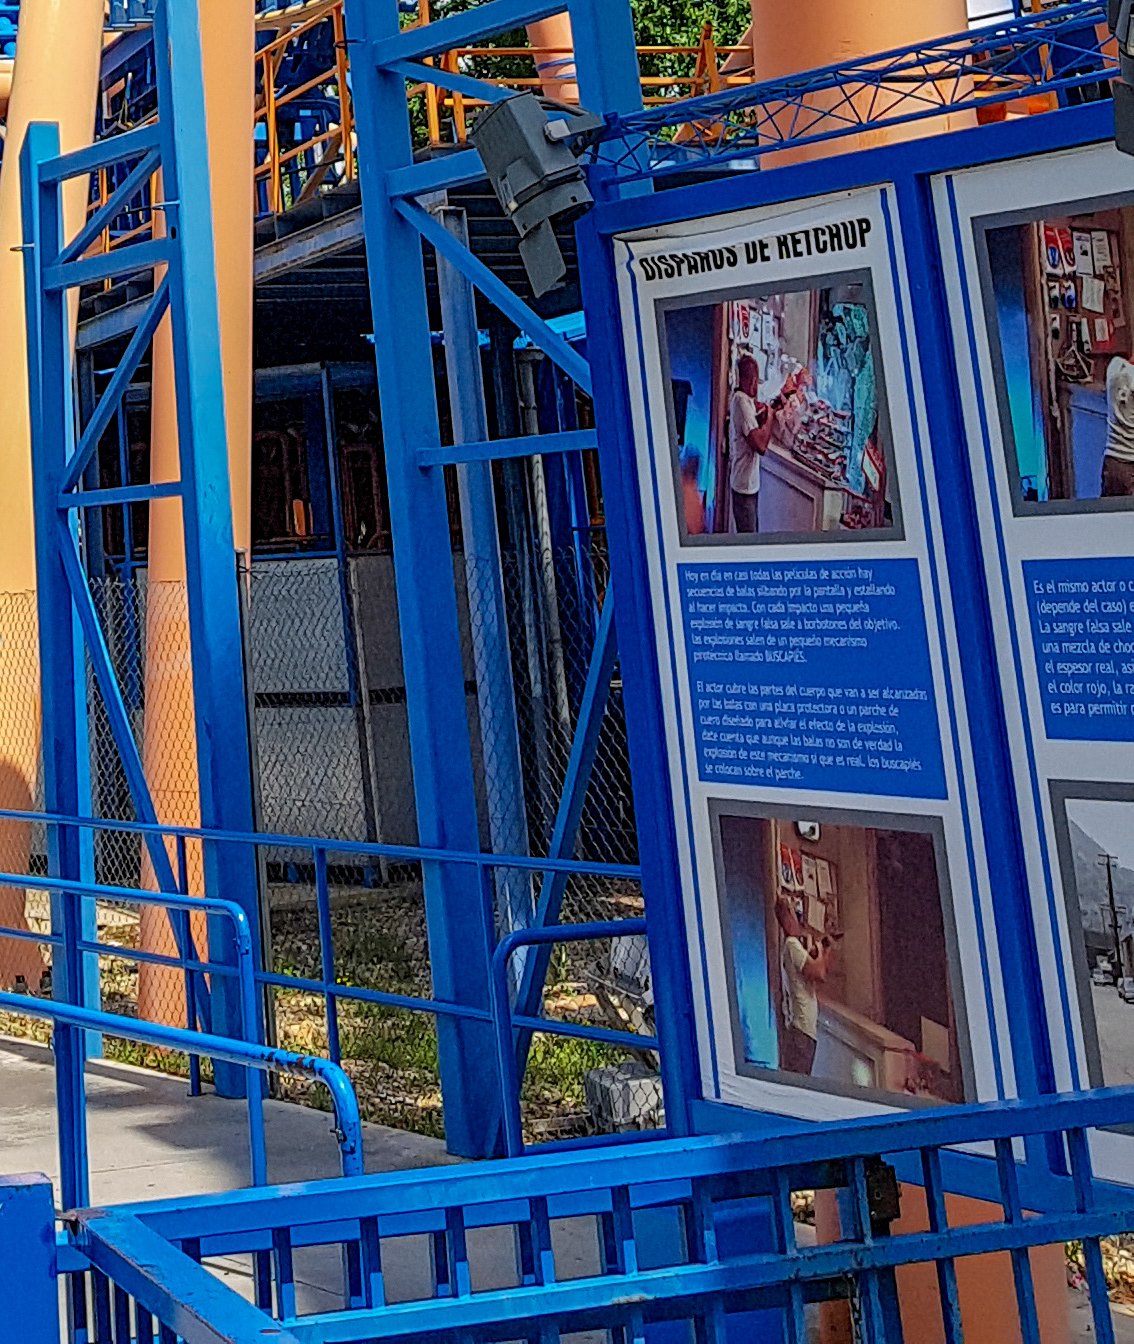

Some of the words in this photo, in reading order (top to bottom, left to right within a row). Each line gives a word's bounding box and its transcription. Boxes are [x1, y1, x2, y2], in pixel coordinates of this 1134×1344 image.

[744, 239, 771, 265] DE
[775, 218, 872, 260] KETCHUP
[685, 570, 698, 583] Hoy
[700, 572, 709, 581] en
[724, 572, 733, 581] en
[750, 569, 770, 581] todas
[772, 569, 782, 581] las
[820, 568, 829, 580] de
[858, 567, 872, 582] hay
[726, 585, 735, 596] de
[736, 585, 756, 596] balas
[790, 587, 801, 598] por
[804, 585, 811, 596] la
[814, 584, 845, 599] pantalla
[847, 587, 852, 599] y
[854, 583, 896, 596] estallando
[1034, 580, 1045, 594] Es
[1047, 580, 1056, 594] el
[1058, 580, 1089, 593] mismo
[1092, 579, 1116, 593] actor
[1119, 581, 1126, 592] o
[689, 602, 695, 612] al
[752, 601, 766, 614] Con
[768, 601, 785, 613] cada
[819, 603, 833, 613] una
[1037, 600, 1081, 616] (depende
[1084, 598, 1099, 613] del
[1101, 598, 1127, 616] caso)
[725, 617, 734, 629] de
[780, 617, 796, 629] sale
[804, 617, 847, 630] borbotones
[849, 617, 862, 629] del
[864, 617, 901, 632] objetivo.
[1039, 619, 1051, 634] La
[1053, 622, 1083, 637] sangre
[1086, 618, 1110, 633] falsa
[1112, 618, 1132, 633] sale
[767, 633, 776, 645] de
[778, 636, 788, 646] un
[823, 635, 867, 647] mecanismo
[1042, 642, 1060, 654] una
[1062, 639, 1096, 654] mezcla
[1099, 639, 1111, 653] de
[1045, 660, 1054, 673] el
[1057, 662, 1092, 677] espesor
[1096, 660, 1119, 676] real,
[706, 683, 723, 693] actor
[748, 683, 758, 695] las
[760, 684, 783, 697] partes
[786, 683, 798, 696] del
[799, 686, 825, 699] cuerpo
[828, 687, 842, 699] que
[845, 688, 858, 698] van
[860, 689, 866, 699] a
[868, 688, 879, 699] ser
[882, 685, 928, 701] alcanzadas
[1048, 679, 1057, 693] el
[1060, 679, 1083, 694] color
[1086, 680, 1110, 698] rojo,
[1113, 679, 1123, 695] la
[698, 699, 710, 710] por
[712, 698, 722, 710] las
[744, 701, 757, 711] con
[759, 702, 773, 712] una
[774, 699, 795, 714] placa
[797, 702, 837, 715] protectora
[839, 704, 845, 714] o
[846, 704, 857, 715] un
[859, 704, 886, 717] parche
[889, 703, 899, 717] de
[1051, 702, 1061, 714] es
[1064, 702, 1085, 716] para
[1088, 700, 1127, 717] permitir
[700, 715, 720, 725] cuero
[755, 717, 772, 730] para
[799, 718, 807, 730] el
[808, 718, 833, 731] efecto
[836, 719, 845, 732] de
[847, 720, 855, 732] la
[746, 734, 760, 746] que
[762, 734, 788, 748] aunque
[790, 733, 801, 746] las
[803, 734, 823, 748] balas
[826, 739, 835, 749] no
[837, 739, 851, 749] son
[852, 737, 863, 749] de
[864, 738, 893, 751] verdad
[894, 738, 903, 752] la
[738, 747, 747, 760] de
[750, 751, 765, 761] este
[819, 754, 833, 767] que
[835, 755, 845, 766] es
[705, 763, 713, 774] se
[715, 763, 742, 776] colocan
[744, 764, 764, 777] sobre
[766, 766, 774, 778] el
